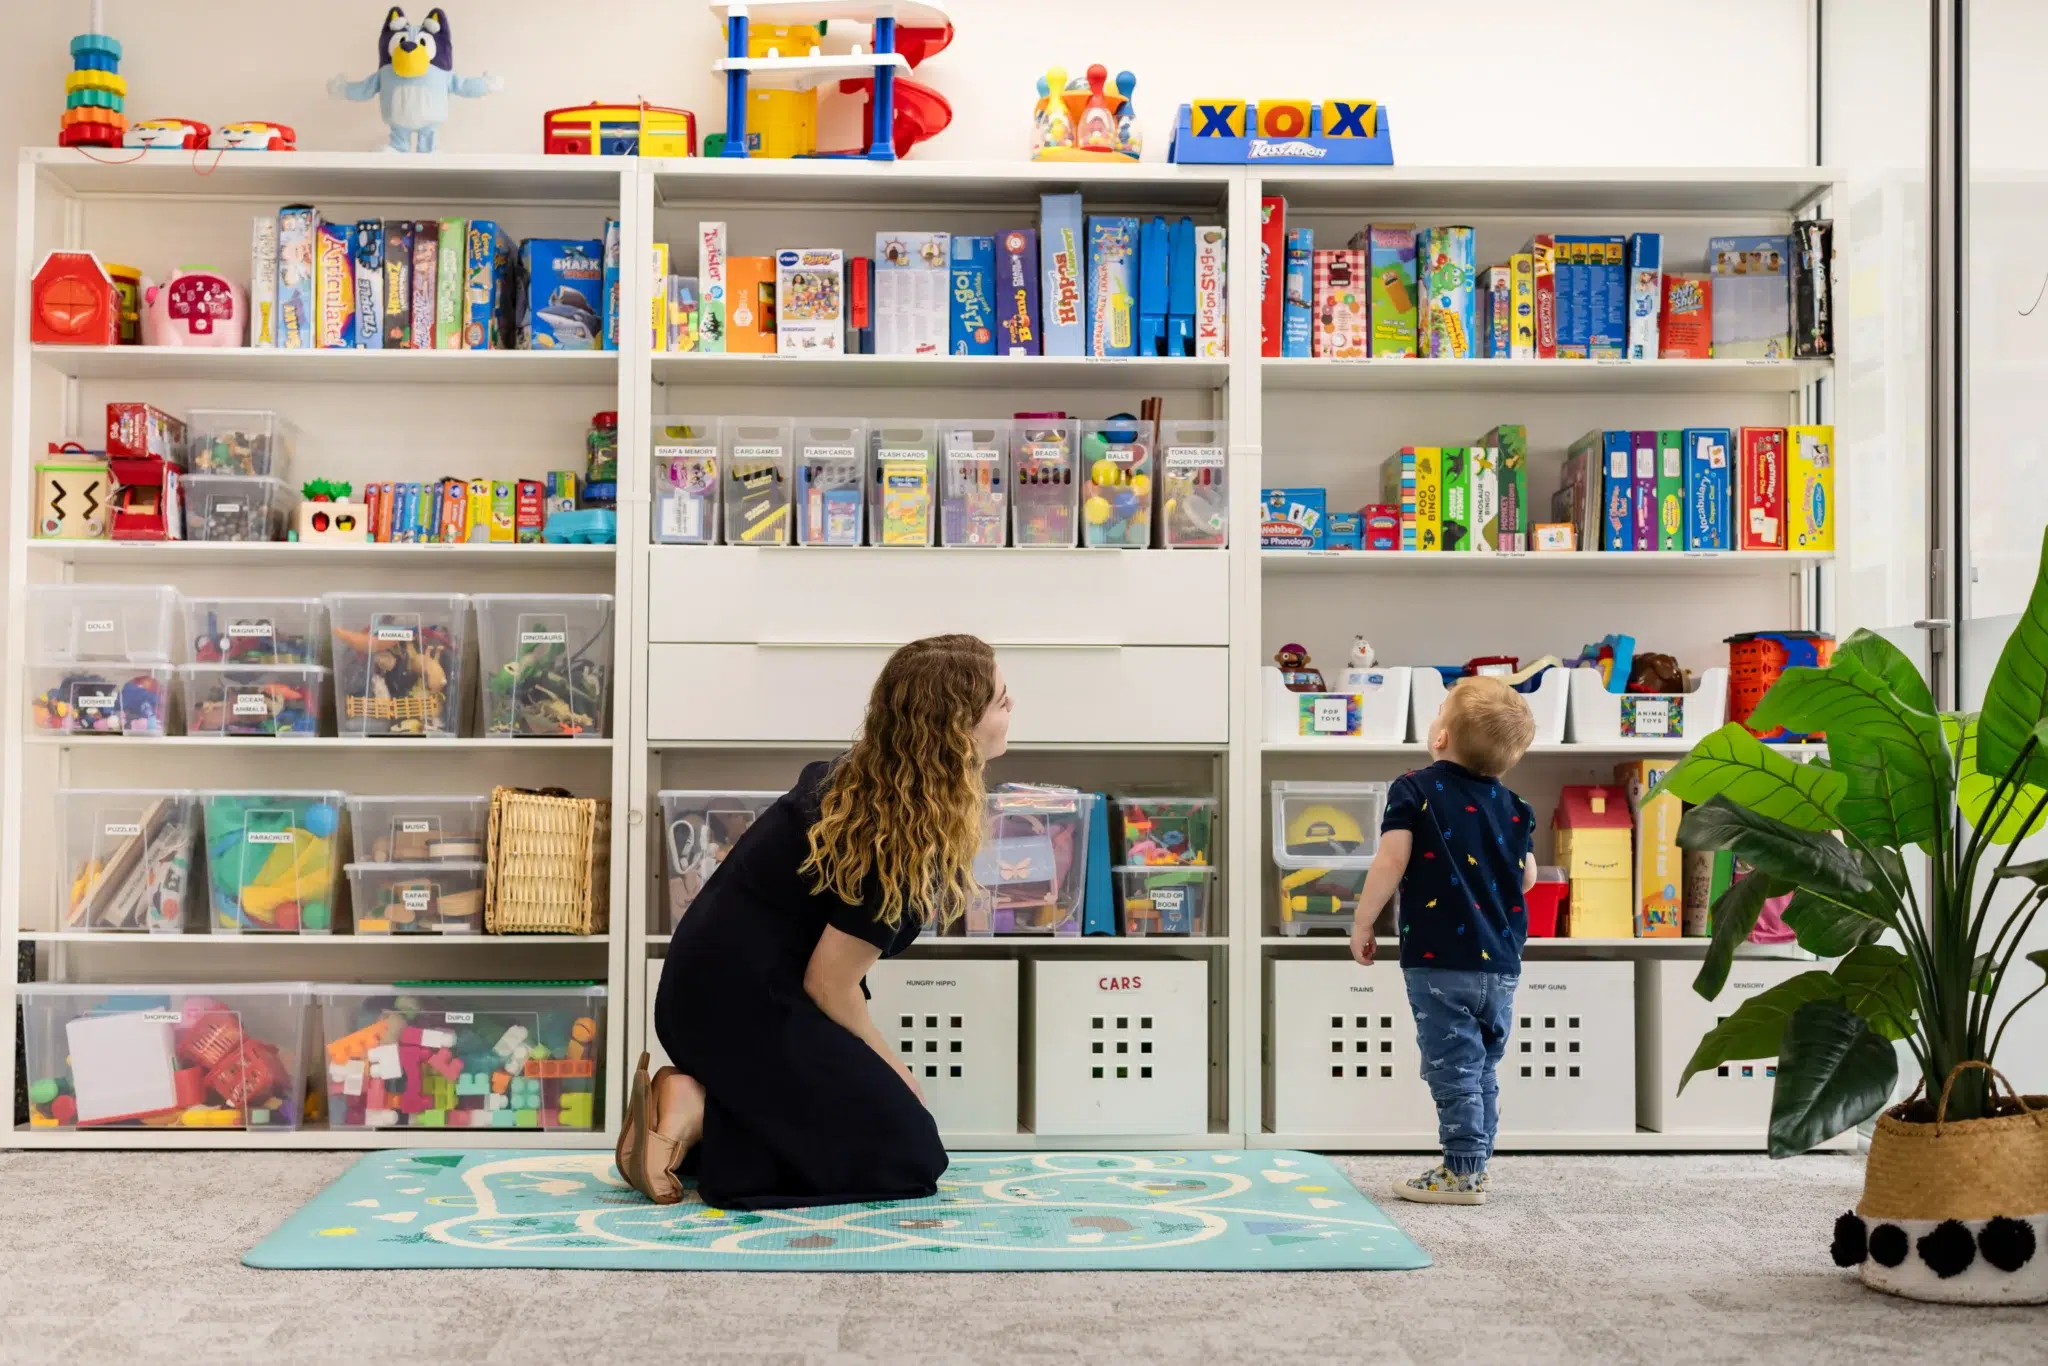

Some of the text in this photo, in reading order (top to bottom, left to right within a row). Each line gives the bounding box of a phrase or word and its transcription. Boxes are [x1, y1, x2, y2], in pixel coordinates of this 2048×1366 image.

[1198, 103, 1371, 137] X O X
[553, 257, 600, 270] SHARK
[704, 229, 721, 281] Twister
[1200, 248, 1215, 291] Stage
[196, 281, 204, 291] 2
[323, 235, 348, 347] Articulate!
[1054, 253, 1077, 325] Hippos
[357, 278, 378, 338] TAPPLE
[953, 271, 985, 343] Zingo!
[1171, 449, 1198, 457] TOKENS,
[1765, 451, 1777, 499] Grammar
[1419, 490, 1427, 515] POO
[1428, 484, 1436, 521] BINGO
[1500, 496, 1509, 530] MONKEY
[1696, 476, 1711, 533] Vocabulary
[1270, 537, 1311, 547] Phonology
[230, 627, 270, 635] MAGNETICA
[381, 632, 410, 640] ANIMALS
[523, 634, 563, 642] DINOSAURS
[1099, 976, 1142, 991] CARS
